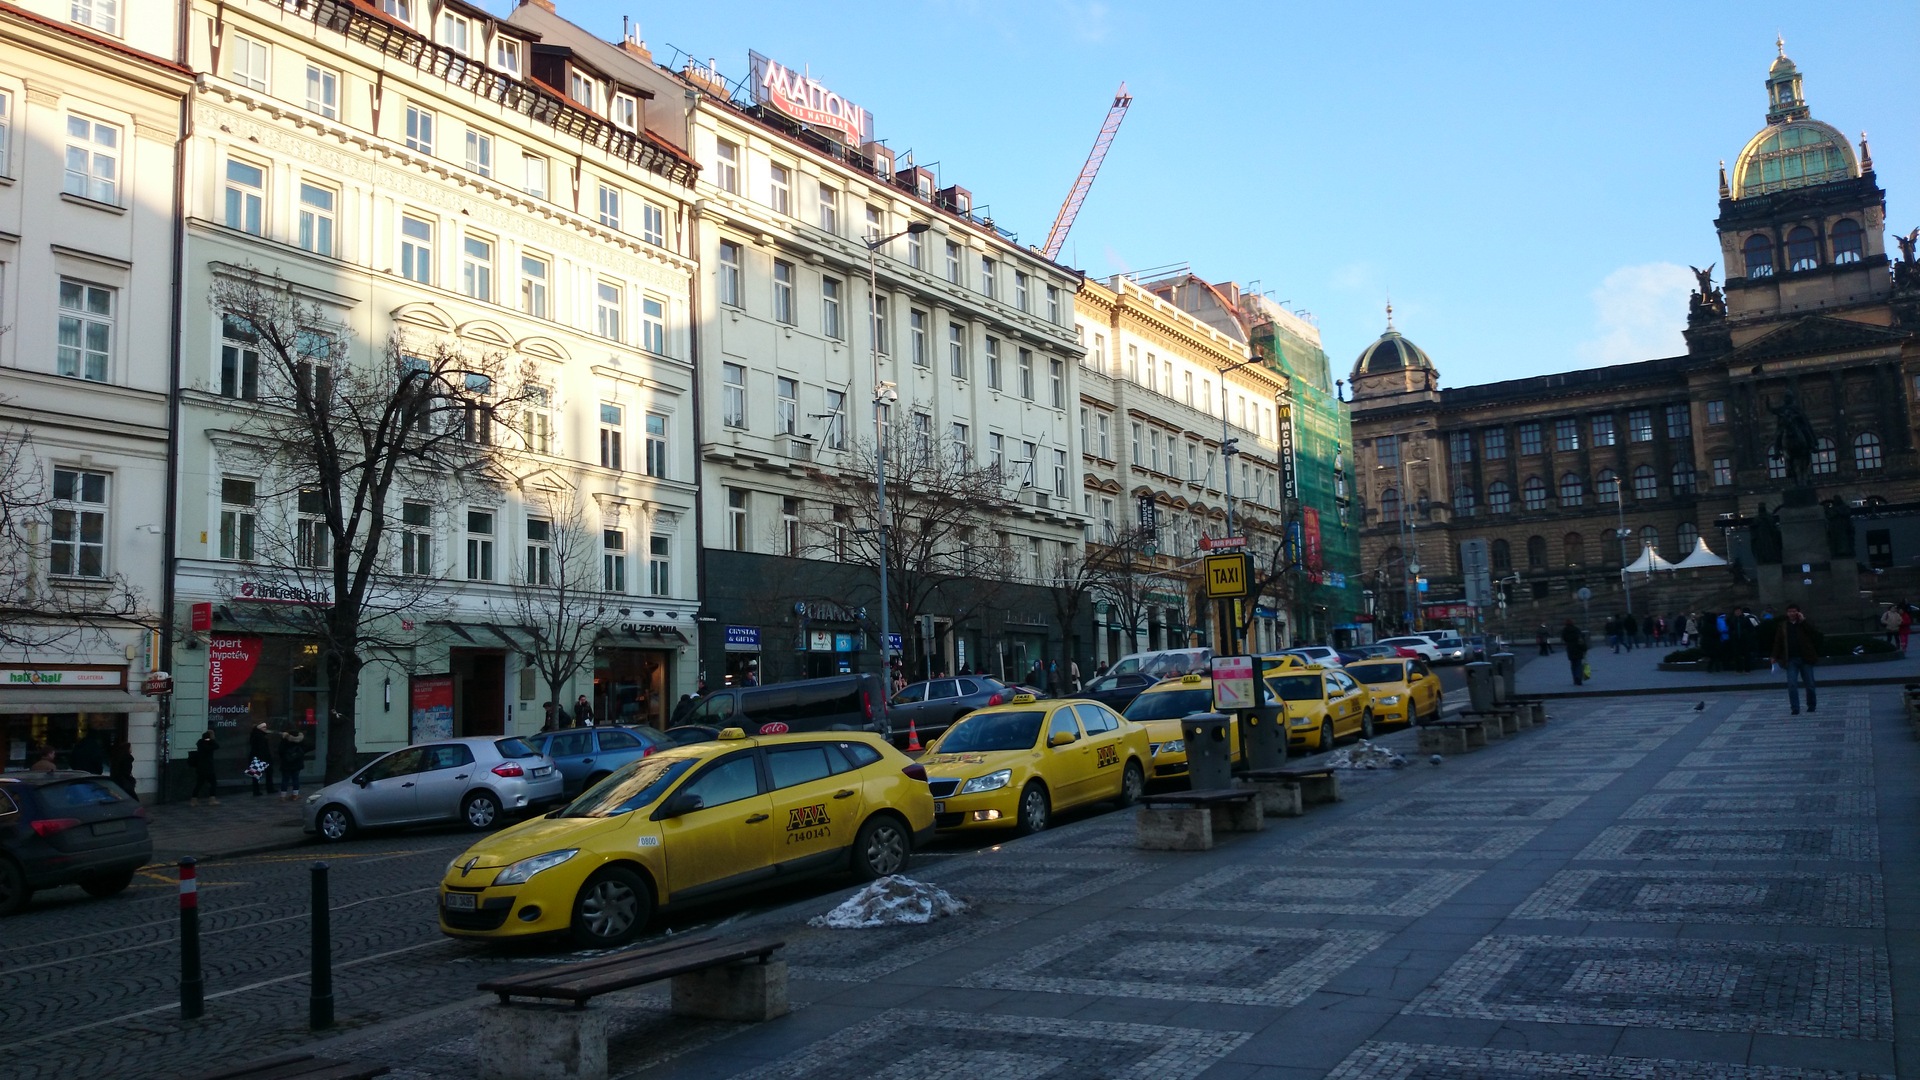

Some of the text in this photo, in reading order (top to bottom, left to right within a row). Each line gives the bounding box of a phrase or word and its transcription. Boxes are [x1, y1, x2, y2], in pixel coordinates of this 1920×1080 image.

[763, 60, 864, 137] MATTONI
[788, 106, 849, 131] VIS NATURAE
[1281, 421, 1294, 499] McDonald's
[1211, 538, 1245, 548] FAIR PLACE
[1213, 567, 1239, 584] TAXI
[620, 623, 678, 634] CALZEDONIA
[728, 628, 758, 636] CRYSTAL
[212, 650, 249, 661] hypotéky
[10, 672, 31, 683] half
[40, 673, 62, 683] half
[786, 803, 831, 832] AAA
[786, 825, 831, 845] (14014)
